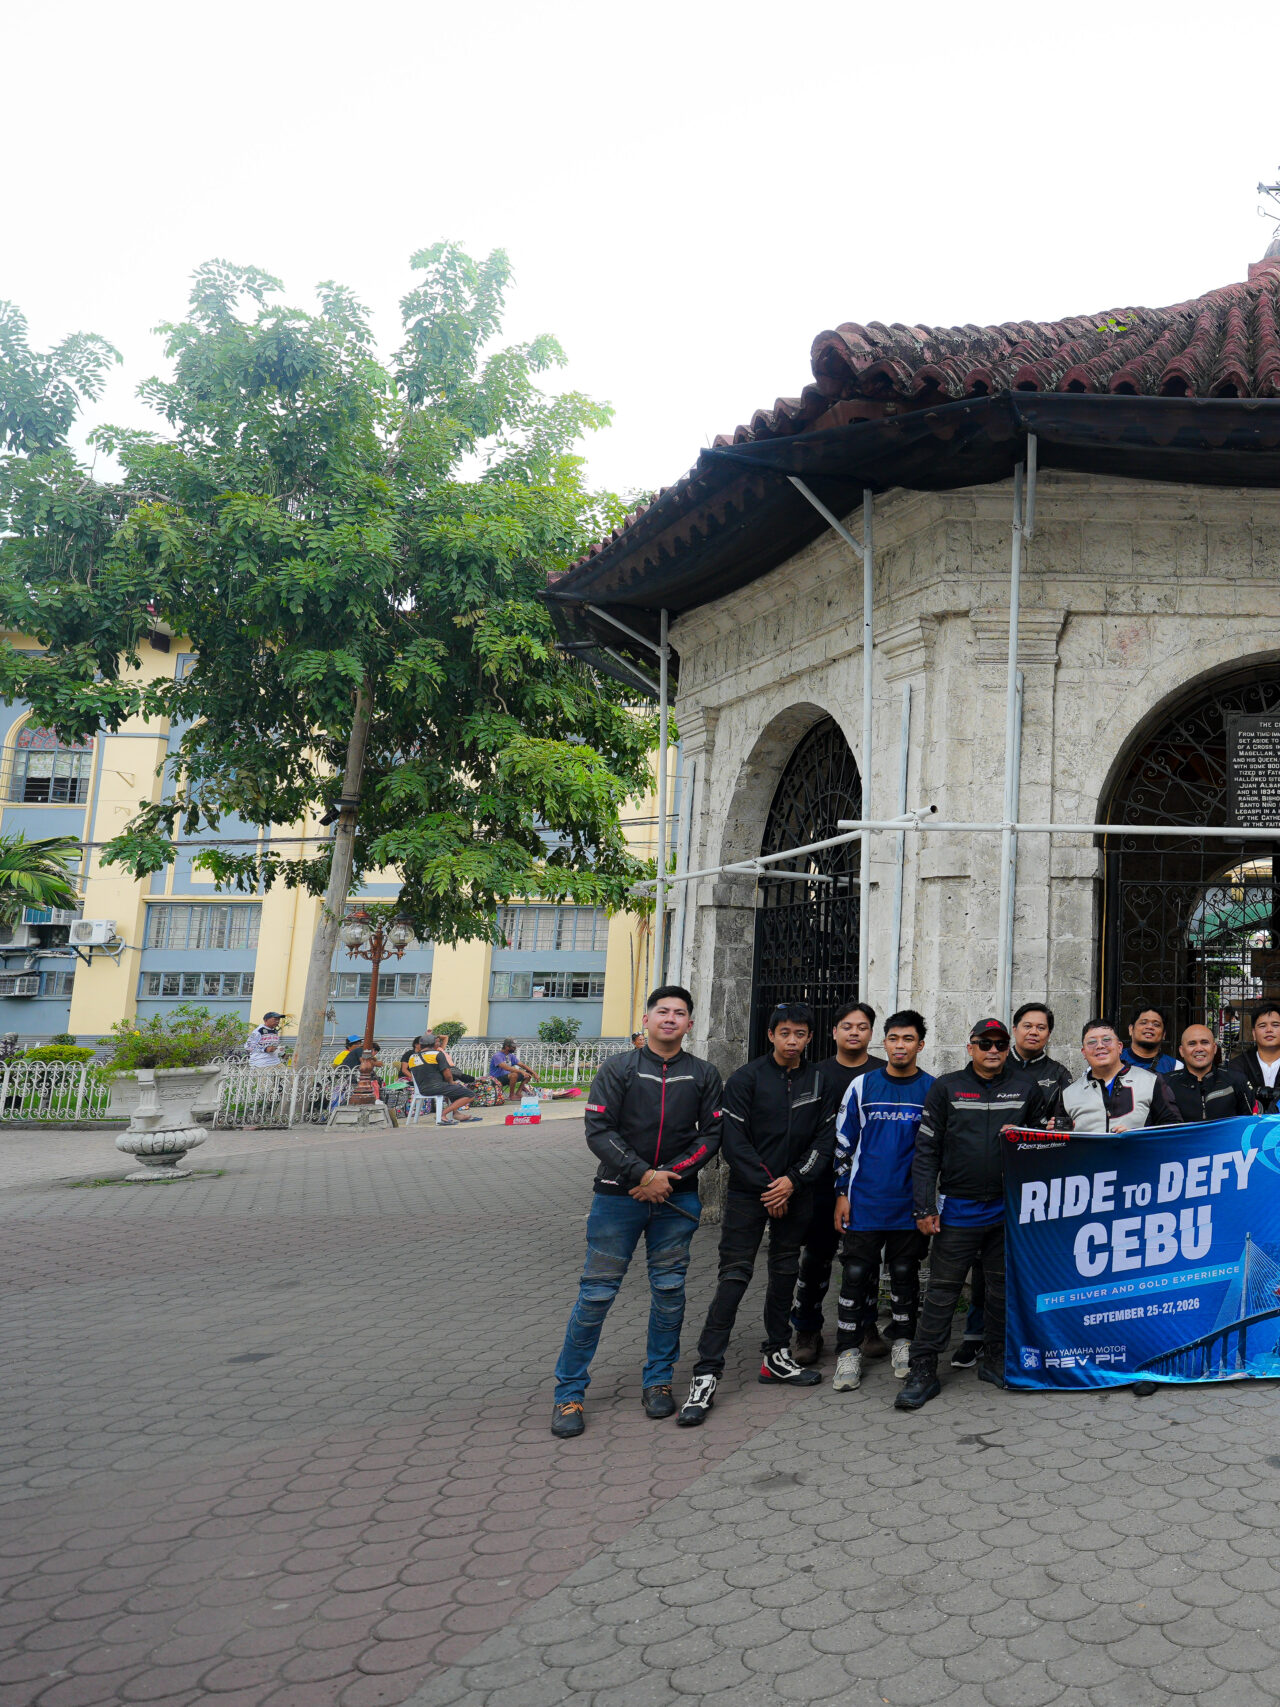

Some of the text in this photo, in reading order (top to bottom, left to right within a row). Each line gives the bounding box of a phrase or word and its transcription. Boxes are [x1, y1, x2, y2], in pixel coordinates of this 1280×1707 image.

[868, 1111, 922, 1121] YAMAHA
[1020, 1131, 1070, 1141] YAMAHA
[1019, 1148, 1258, 1224] RIDE TO DEFY
[1074, 1204, 1212, 1278] CEBU
[1044, 1266, 1240, 1305] THE SILVER AND GOLD EXPERIENCE
[1084, 1306, 1144, 1326] SEPTEMBER
[1176, 1298, 1200, 1312] 2026
[1045, 1345, 1126, 1358] MY YAMAHA MOTOR
[1045, 1353, 1126, 1368] REV PH
